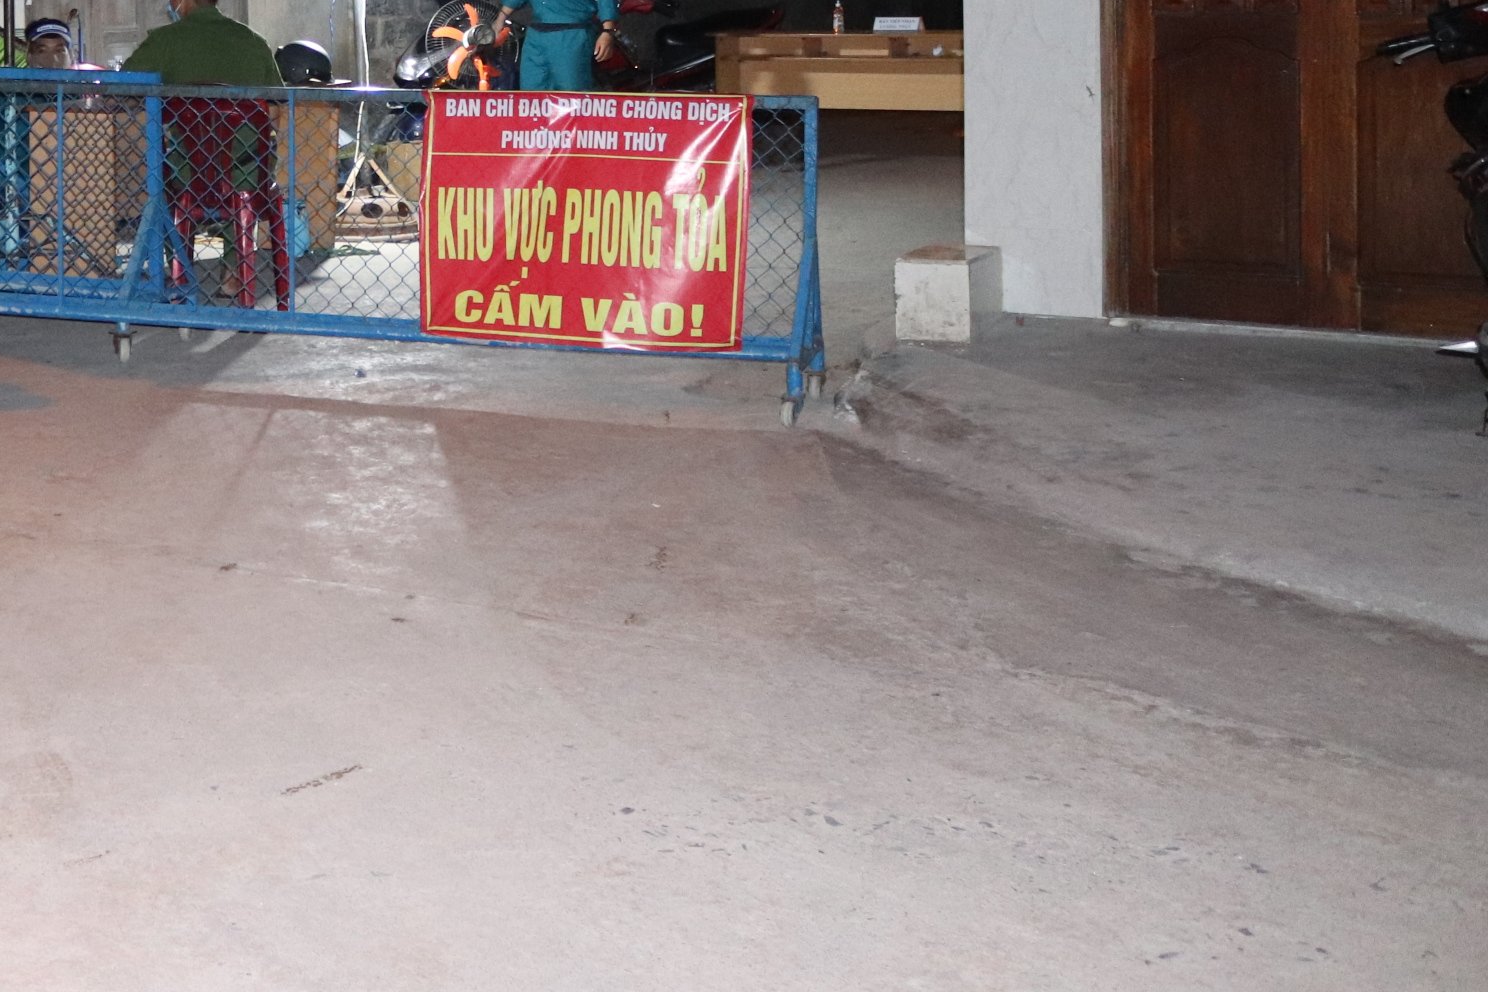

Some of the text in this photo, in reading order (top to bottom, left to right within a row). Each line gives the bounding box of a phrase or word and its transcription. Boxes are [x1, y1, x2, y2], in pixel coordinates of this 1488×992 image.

[446, 98, 481, 117] BAN
[486, 95, 514, 117] CHỈ
[518, 98, 553, 122] ĐẠO
[687, 102, 730, 126] DỊCH
[502, 126, 667, 152] PHƯỜNG NINH THỦY
[437, 166, 728, 279] KHU VỰC PHONG TỎA
[455, 279, 705, 338] CẤM VÀO!
